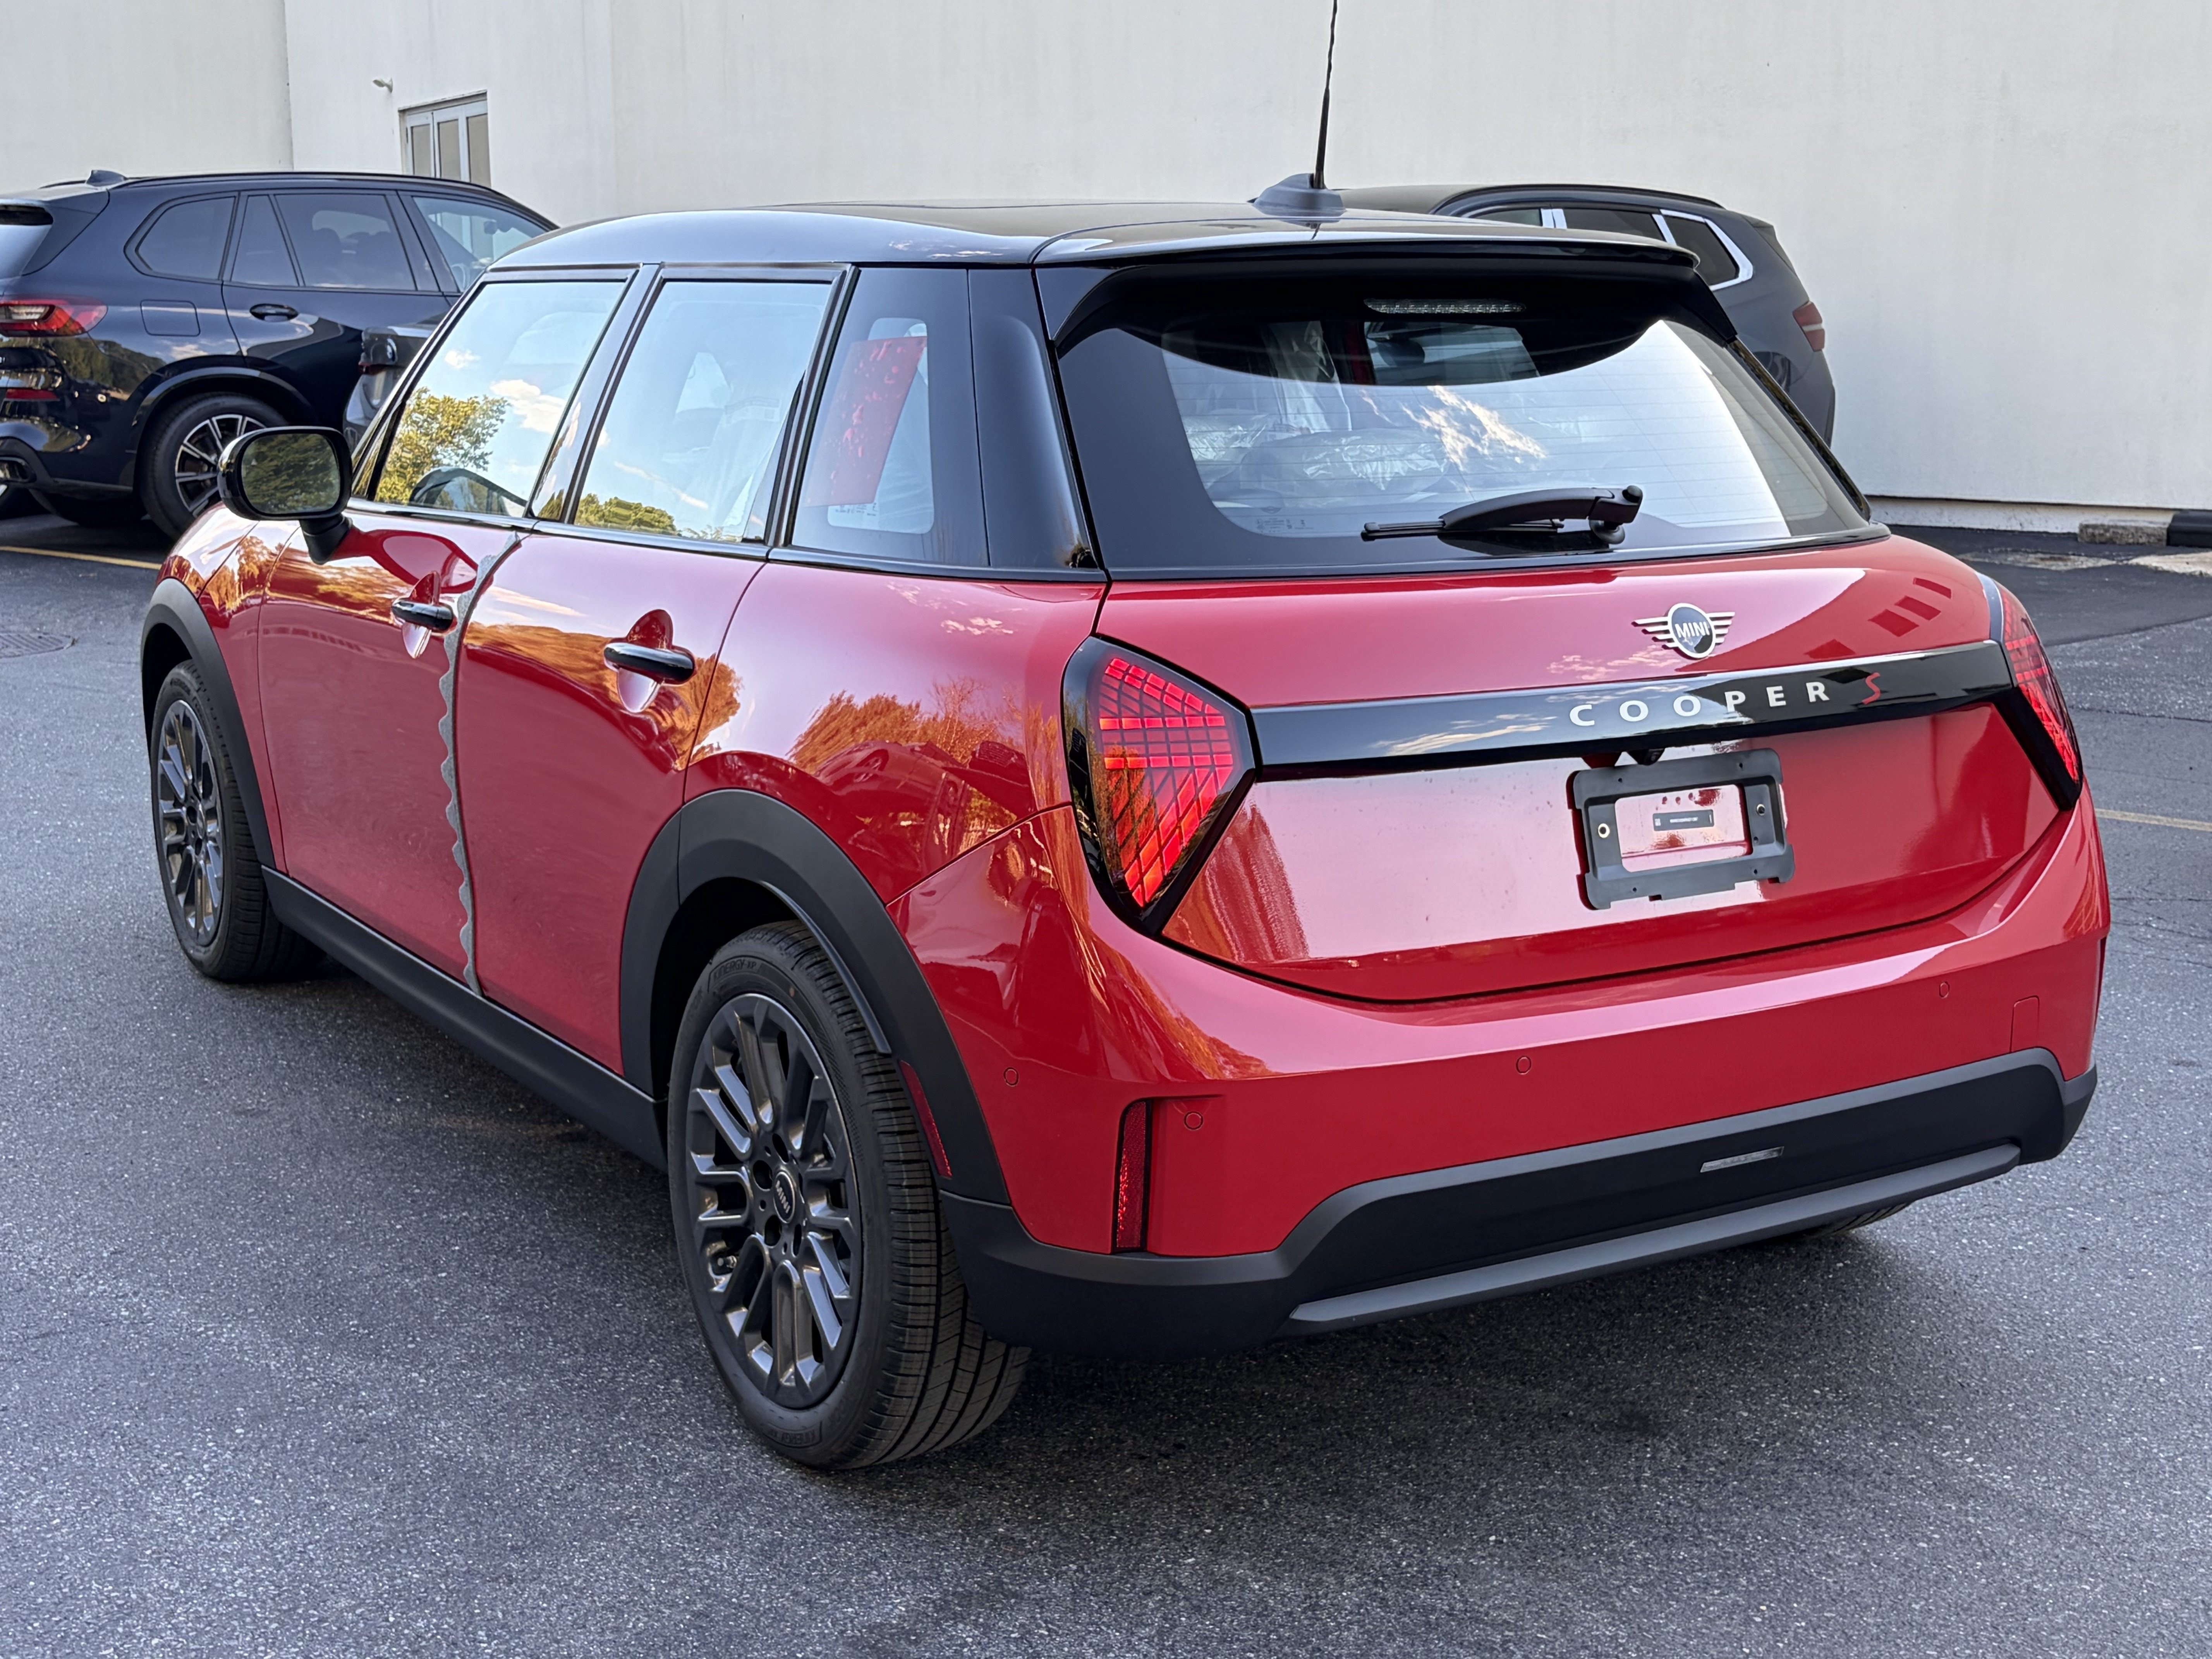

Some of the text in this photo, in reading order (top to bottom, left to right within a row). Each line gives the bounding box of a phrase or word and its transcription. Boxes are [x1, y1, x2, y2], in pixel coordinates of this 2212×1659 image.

[1674, 622, 1710, 638] MINI
[1569, 672, 1881, 727] COOPER S
[775, 1180, 790, 1213] MINI
